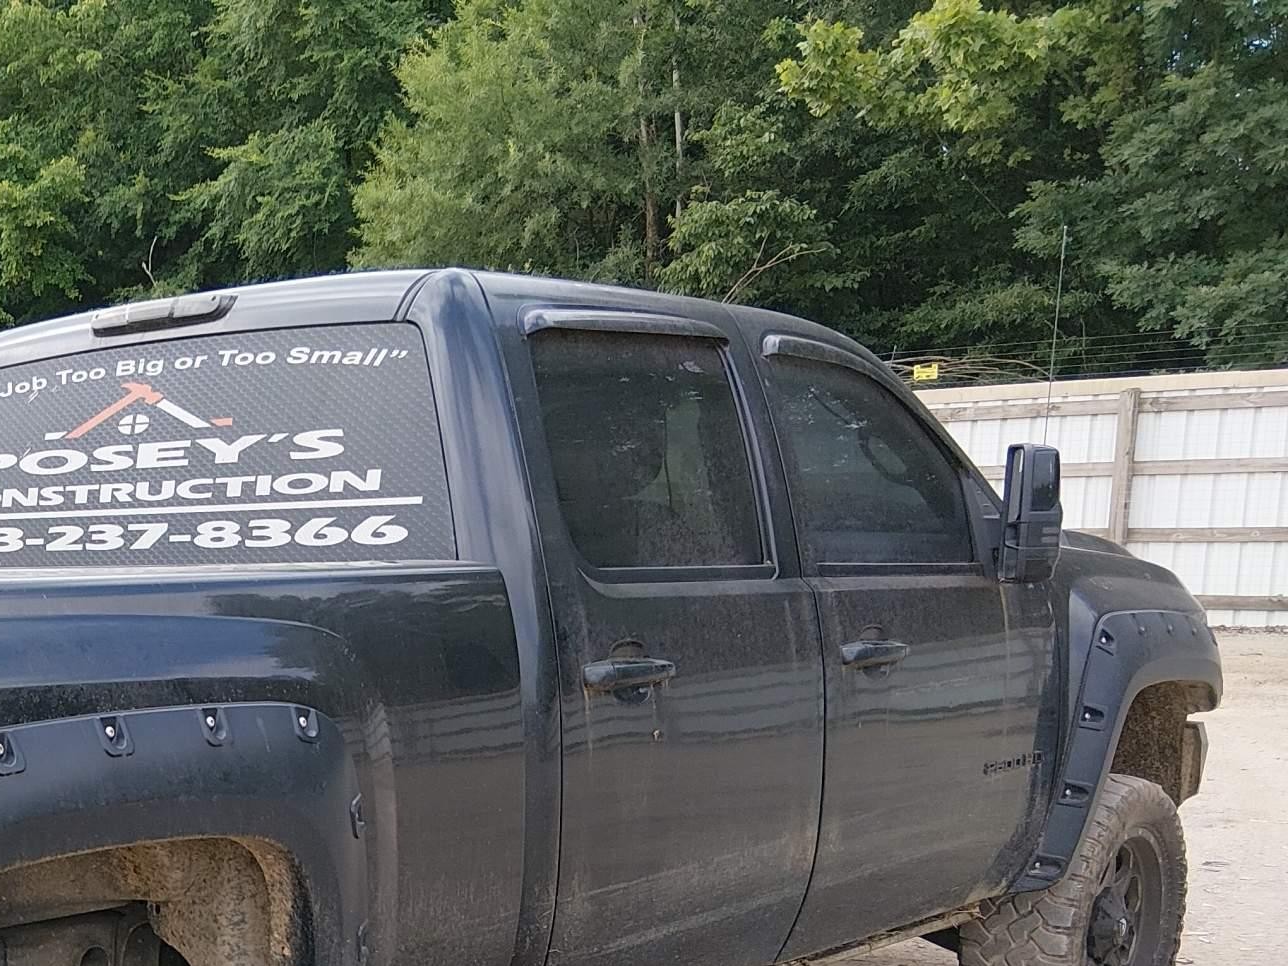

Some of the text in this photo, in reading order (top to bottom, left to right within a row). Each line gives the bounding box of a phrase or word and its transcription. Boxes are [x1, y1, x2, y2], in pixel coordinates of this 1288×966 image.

[0, 376, 48, 398] Job
[56, 366, 106, 385] Too
[116, 358, 164, 376] Big
[174, 356, 208, 370] or
[218, 349, 277, 367] Too
